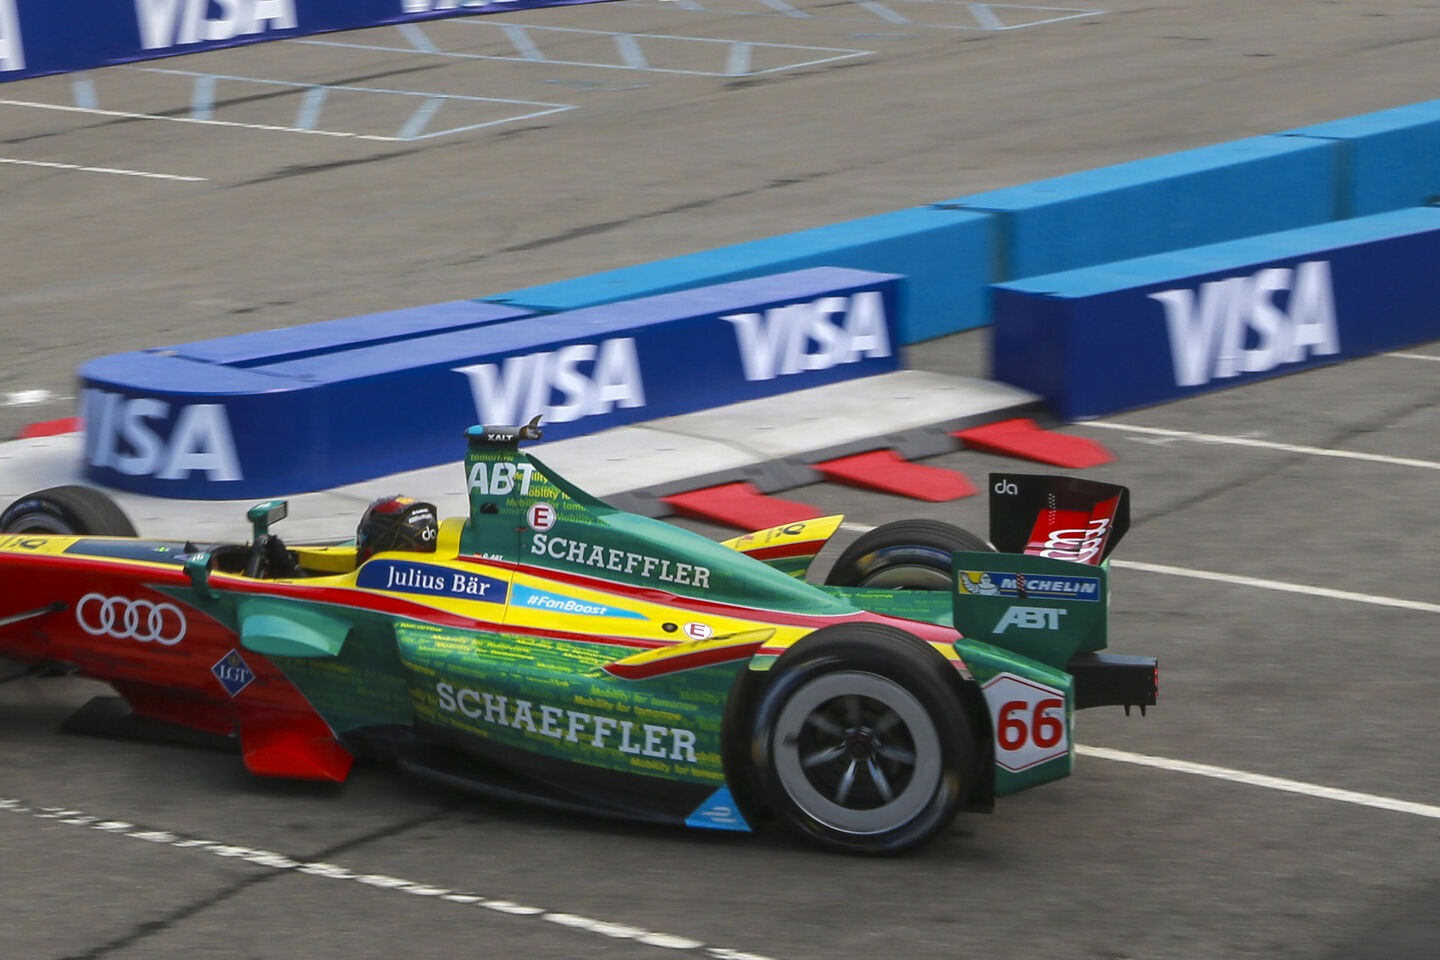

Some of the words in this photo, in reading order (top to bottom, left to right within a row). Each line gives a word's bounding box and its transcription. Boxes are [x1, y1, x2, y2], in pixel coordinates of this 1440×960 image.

[719, 290, 893, 381] VISA
[1147, 260, 1340, 386] VISA
[450, 337, 646, 426] VISA
[468, 462, 536, 496] ABT
[994, 479, 1018, 495] da
[533, 507, 549, 527] E
[531, 534, 710, 589] SCHAEFFLER
[386, 566, 444, 590] Julius
[451, 574, 490, 596] Bär
[1001, 578, 1097, 594] MCHELIN
[527, 595, 607, 616] #FanBoost
[992, 606, 1067, 634] ABT
[220, 664, 248, 683] LGT
[436, 682, 697, 763] SCHAEFFLER
[997, 698, 1063, 750] 66
